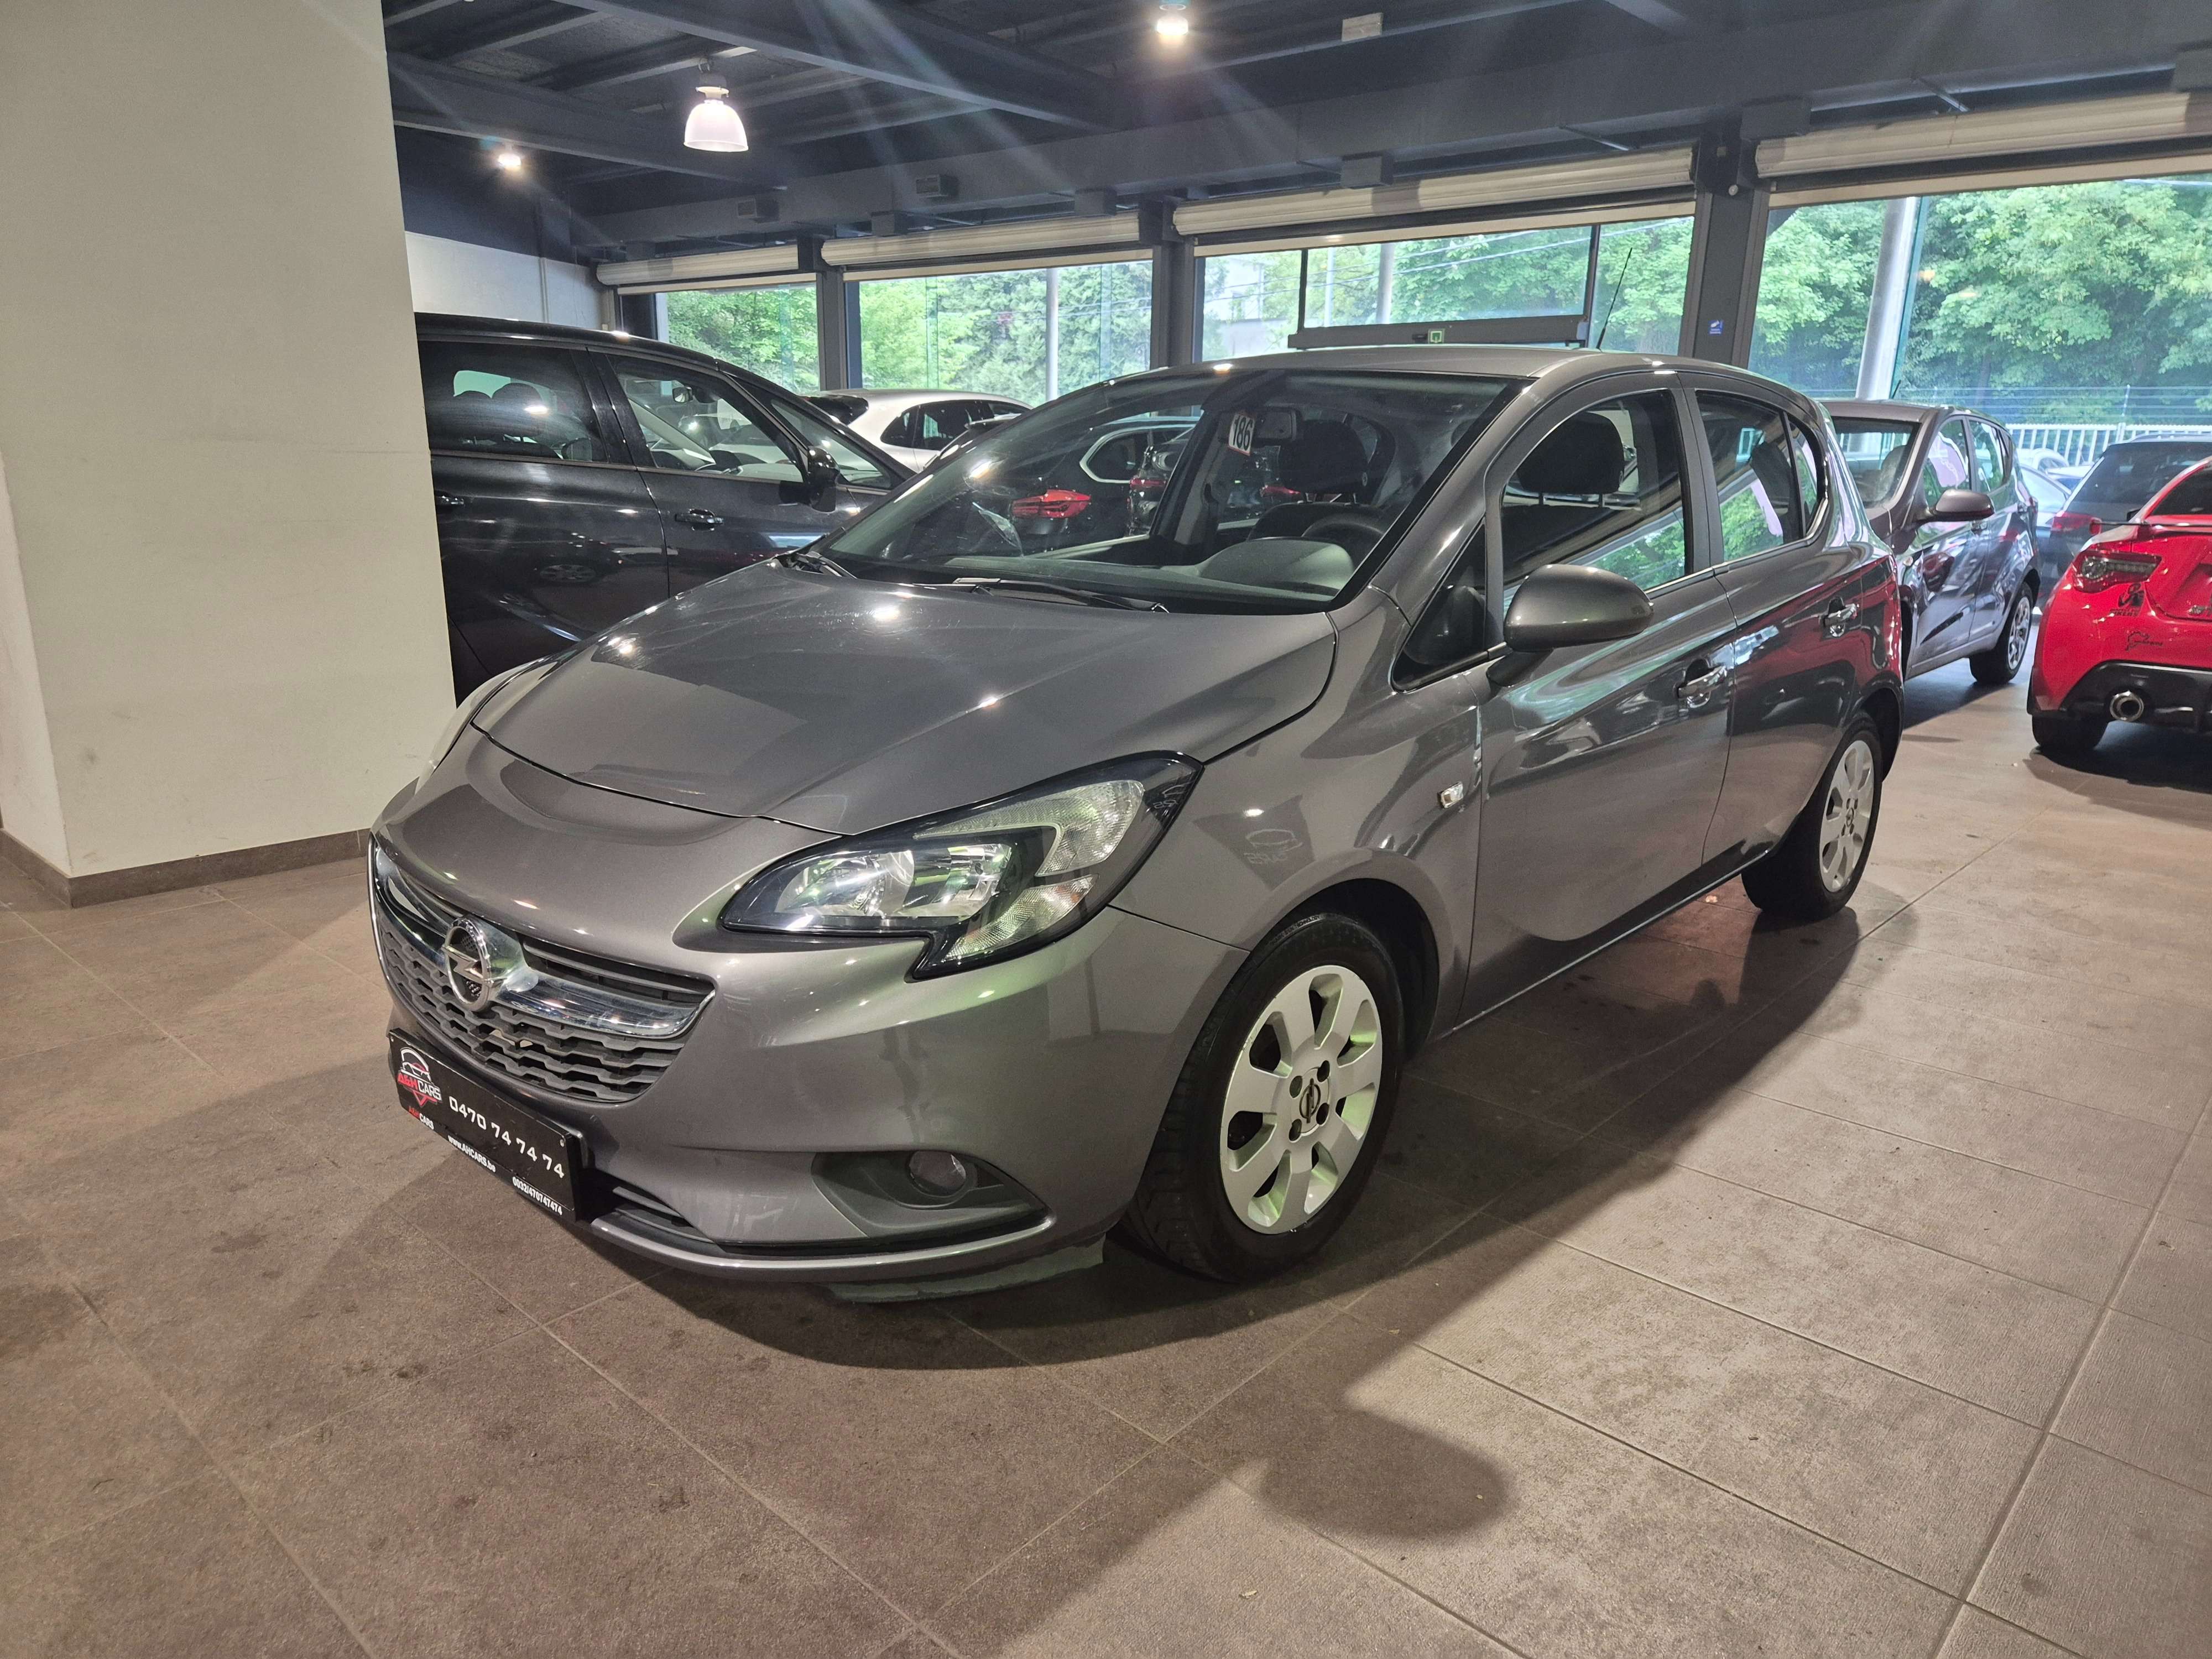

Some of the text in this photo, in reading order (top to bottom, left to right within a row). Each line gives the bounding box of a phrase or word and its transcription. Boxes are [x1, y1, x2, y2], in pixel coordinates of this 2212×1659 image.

[1233, 415, 1253, 451] 186
[417, 1080, 441, 1101] CARS
[419, 1112, 434, 1130] CARS
[448, 1095, 565, 1178] 0470 74 74 74
[447, 1135, 496, 1173] www.AHCARS.be
